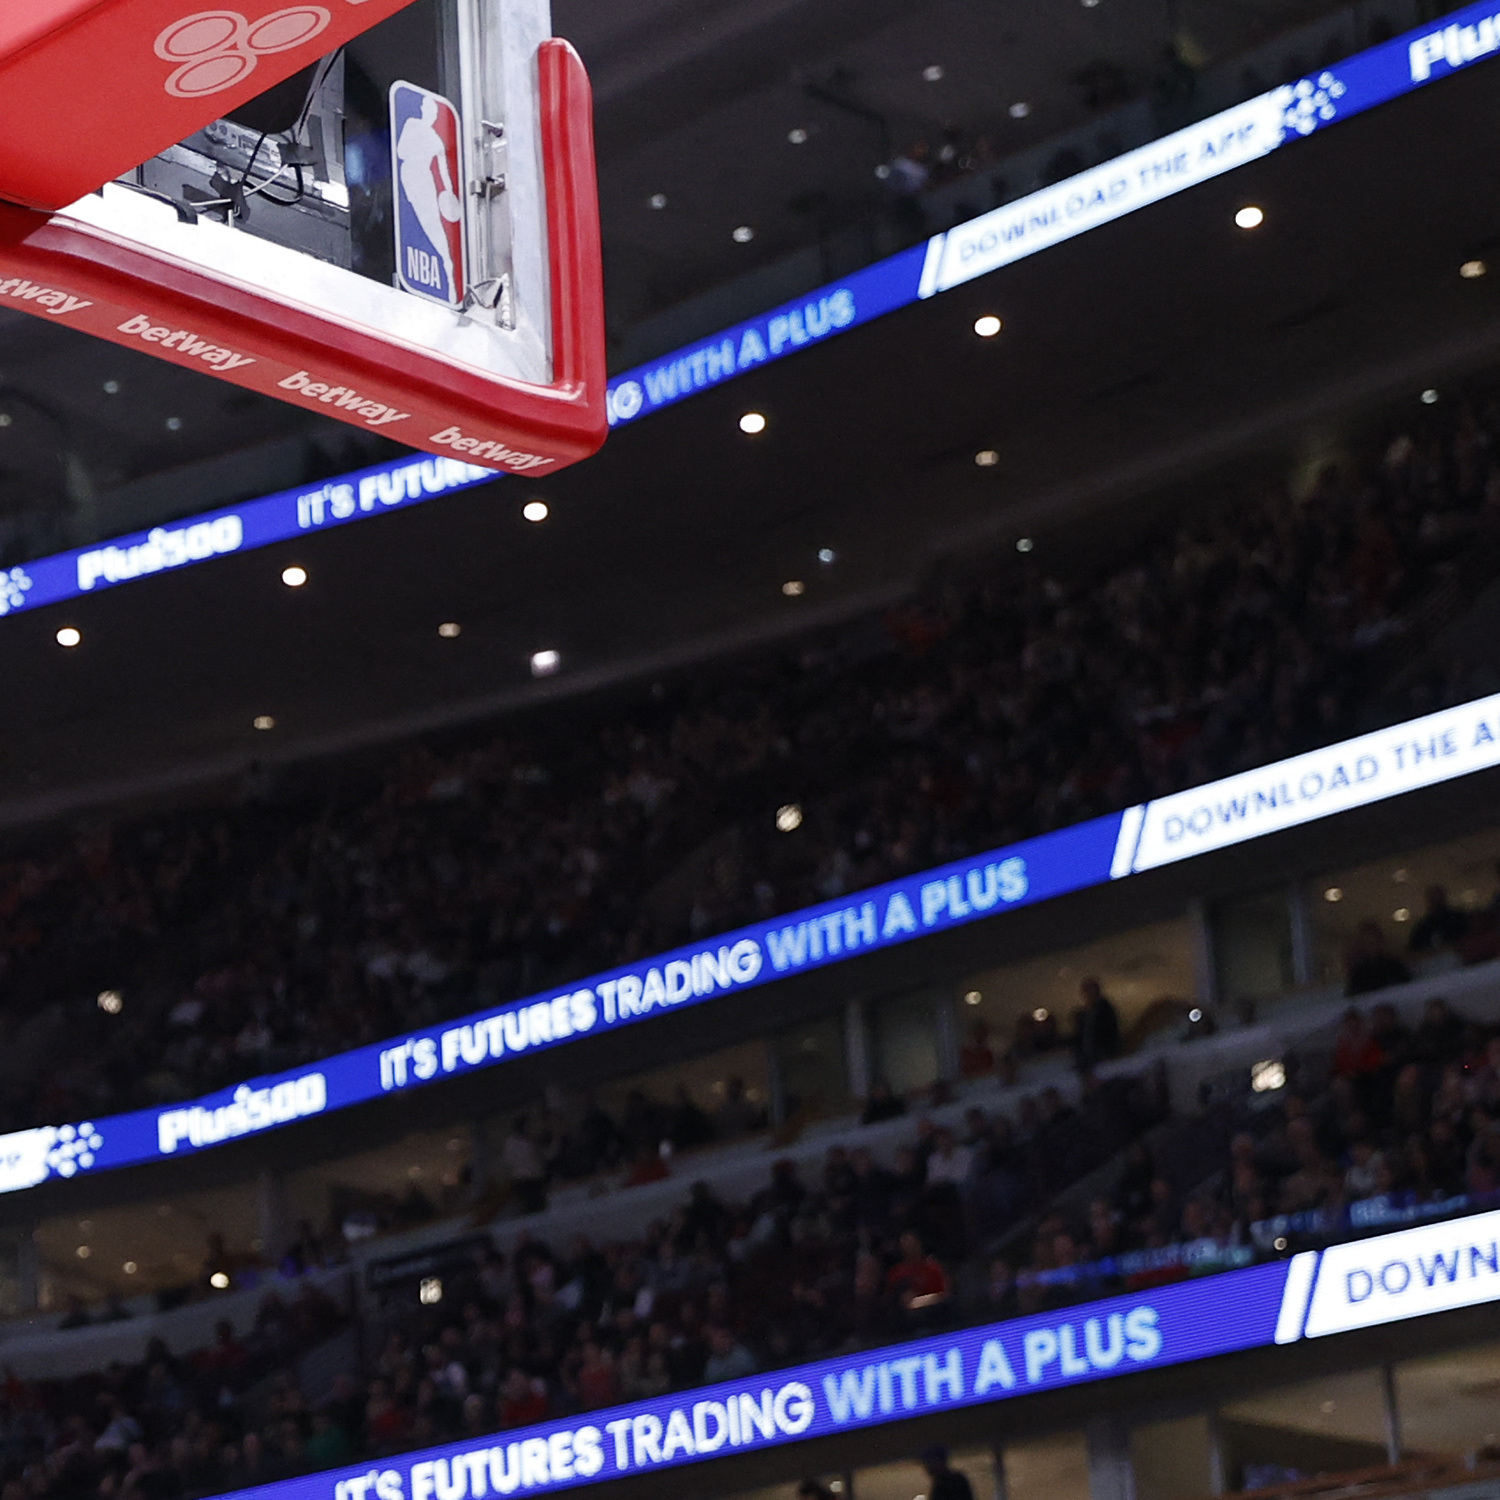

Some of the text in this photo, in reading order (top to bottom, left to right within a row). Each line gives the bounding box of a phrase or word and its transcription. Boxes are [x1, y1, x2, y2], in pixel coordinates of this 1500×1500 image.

[1408, 13, 1500, 83] Plu
[960, 120, 1256, 263] DOWNLOAD THE APP
[406, 245, 441, 291] NBA
[117, 314, 256, 372] betway
[643, 348, 737, 405] WITH
[737, 337, 769, 369] A
[766, 288, 856, 354] PLUS
[278, 370, 411, 428] betway
[428, 426, 555, 472] betway
[297, 482, 355, 529] IT'S
[77, 514, 244, 590] Plus500
[1164, 754, 1380, 843] DOWNLOAD
[1393, 727, 1459, 770] THE
[380, 856, 1028, 1091] IT'S FUTURES TRADING WITH A PLUS
[157, 1072, 326, 1153] Plus500
[1345, 1242, 1500, 1303] DOWN
[605, 1382, 815, 1470] TRADING
[822, 1347, 964, 1424] WITH
[974, 1339, 1015, 1395] A
[1024, 1306, 1163, 1384] PLUS
